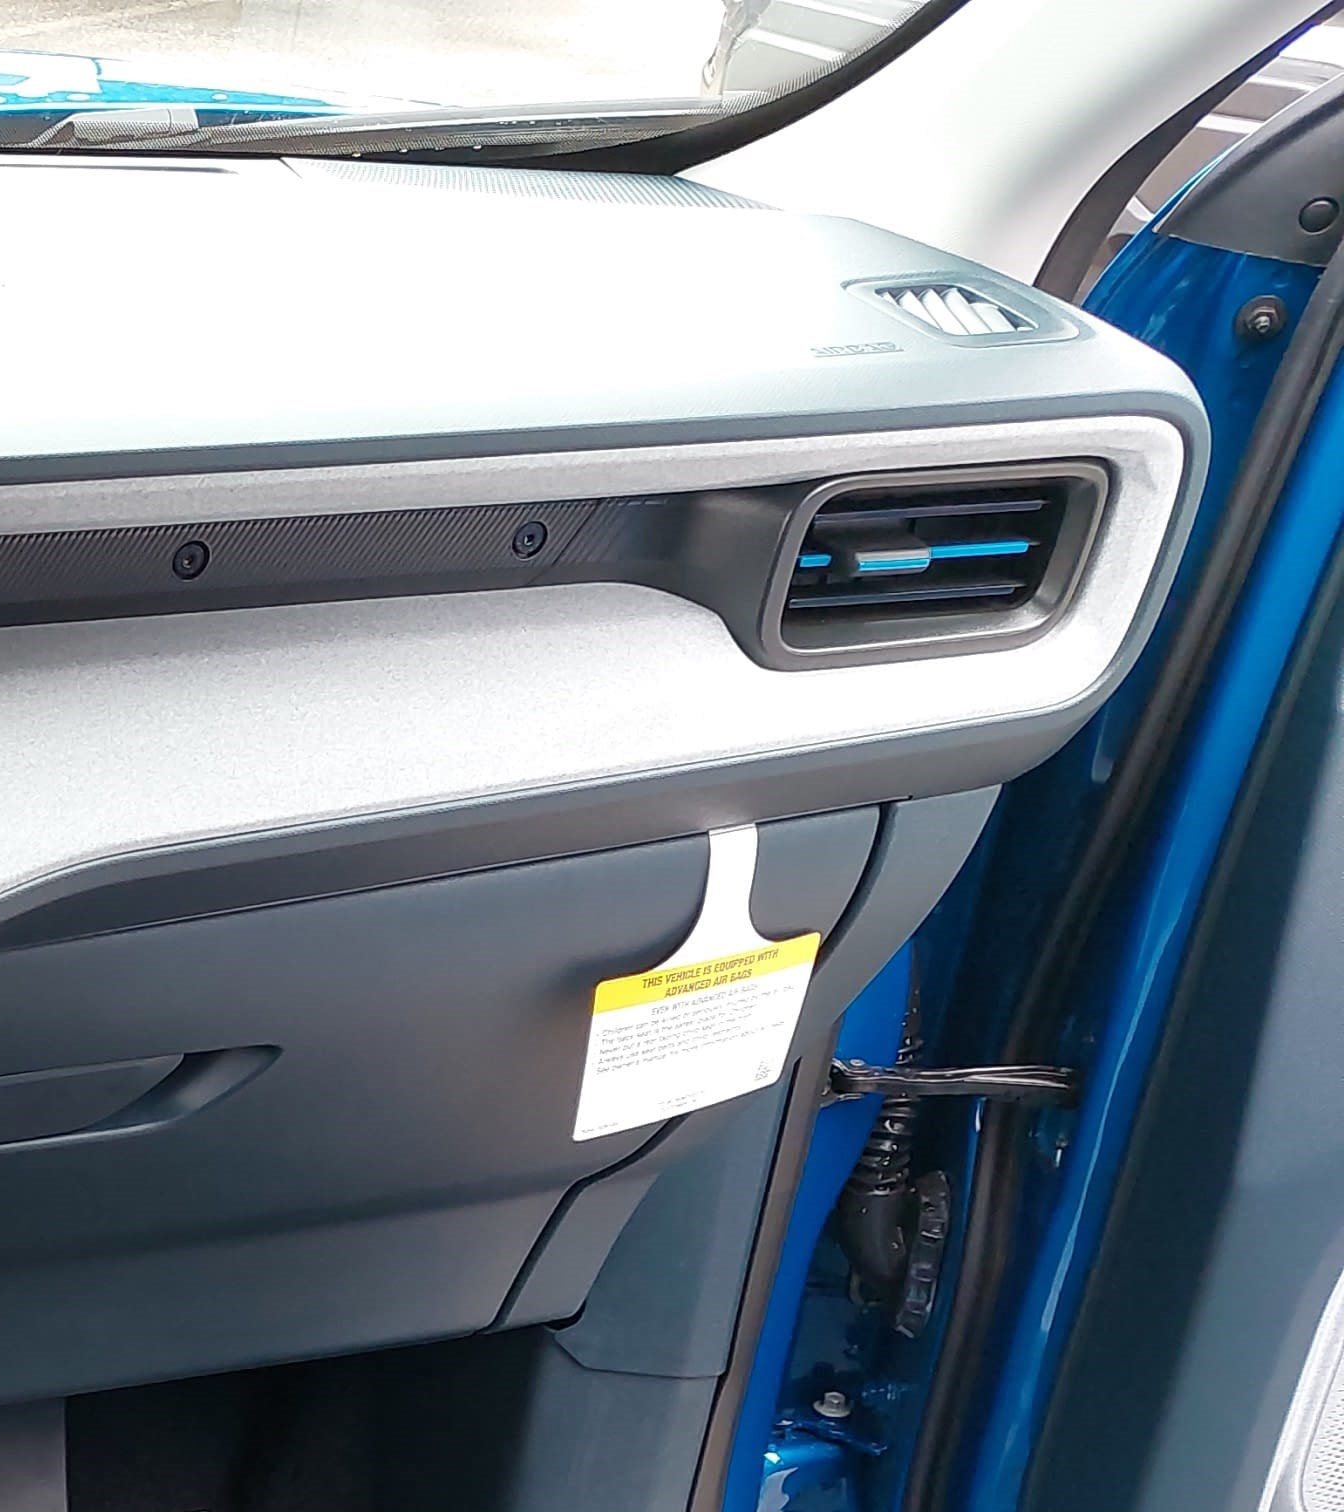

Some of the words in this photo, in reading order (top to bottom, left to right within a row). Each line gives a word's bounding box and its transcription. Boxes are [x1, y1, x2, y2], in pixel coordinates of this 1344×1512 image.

[642, 976, 663, 989] THIS
[665, 967, 701, 985] VEHICLE
[702, 965, 712, 976] IS
[714, 955, 755, 972] EQUIPPED
[757, 949, 779, 962] WITH
[664, 979, 711, 998] ADVANCED
[712, 974, 728, 987] AIR
[729, 969, 752, 983] BAGS
